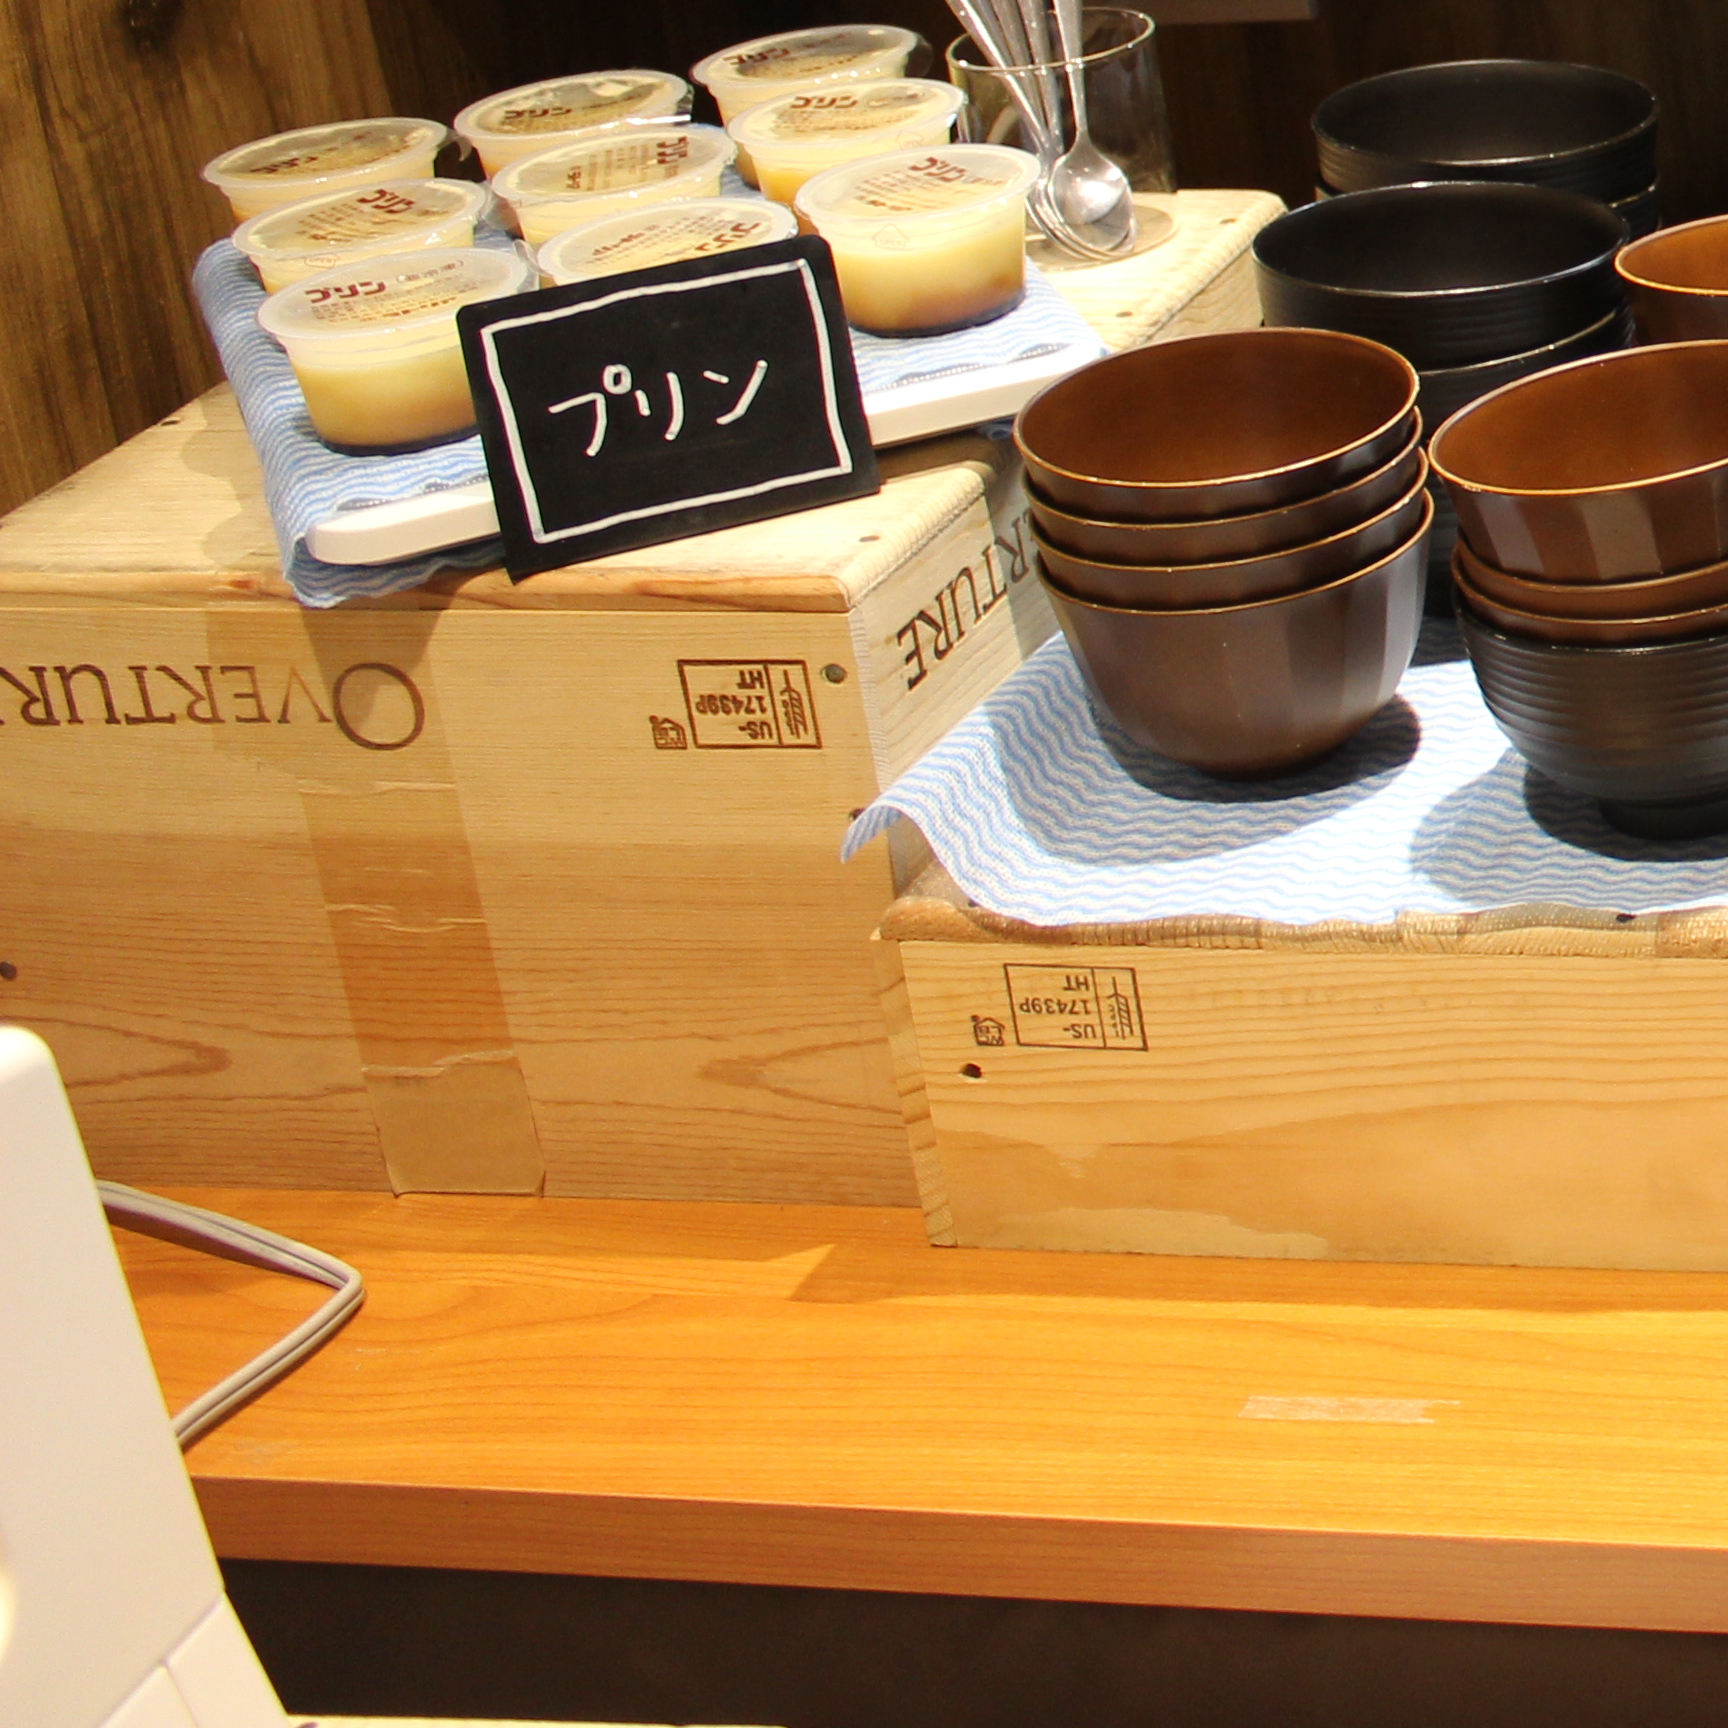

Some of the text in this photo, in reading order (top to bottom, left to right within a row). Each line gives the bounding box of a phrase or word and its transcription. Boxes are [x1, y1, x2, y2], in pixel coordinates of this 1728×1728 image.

[790, 94, 860, 110] プリン
[909, 156, 969, 184] プリン
[356, 187, 416, 214] プリン
[304, 279, 388, 304] プリン
[548, 359, 771, 459] プリン
[737, 670, 765, 690] HT
[0, 663, 425, 752] OVERTUR
[737, 721, 773, 740] US-
[1062, 975, 1090, 991] HT
[1019, 997, 1092, 1015] 17439P
[1062, 1023, 1097, 1039] US-
